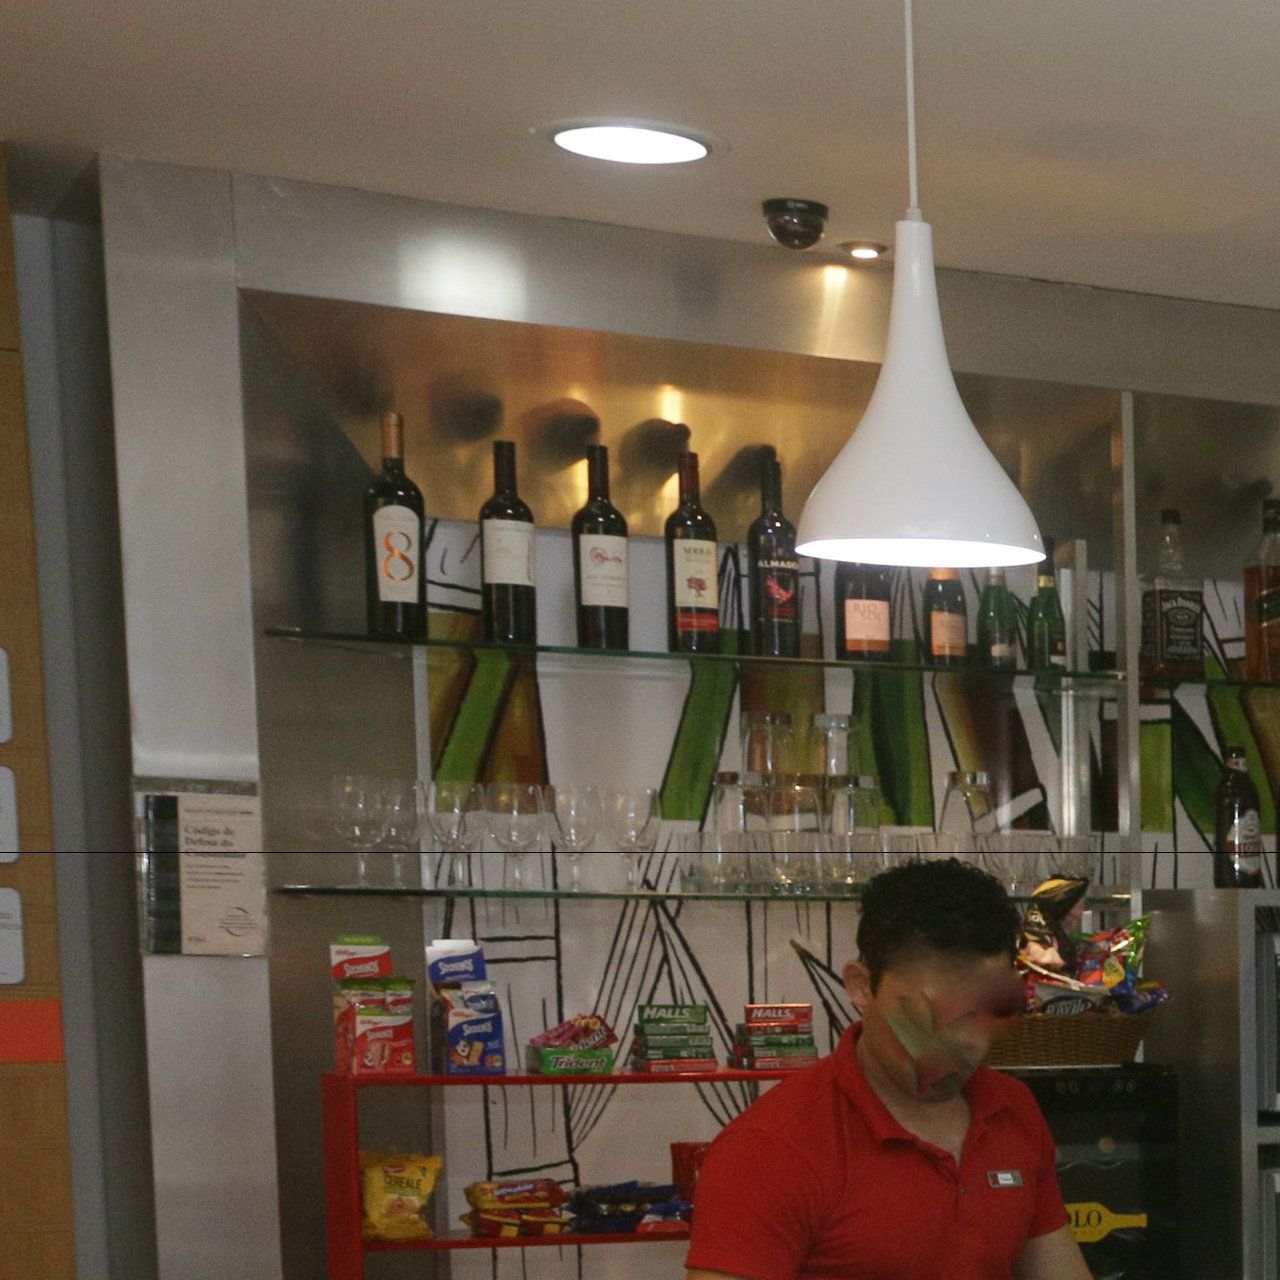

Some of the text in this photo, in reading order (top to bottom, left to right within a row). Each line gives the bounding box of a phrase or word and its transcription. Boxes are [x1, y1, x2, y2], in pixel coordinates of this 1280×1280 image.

[383, 531, 414, 581] 8
[643, 1006, 691, 1019] HALLS
[751, 1007, 792, 1019] HALLS
[550, 1054, 607, 1069] Trident
[1067, 1210, 1102, 1229] LO
